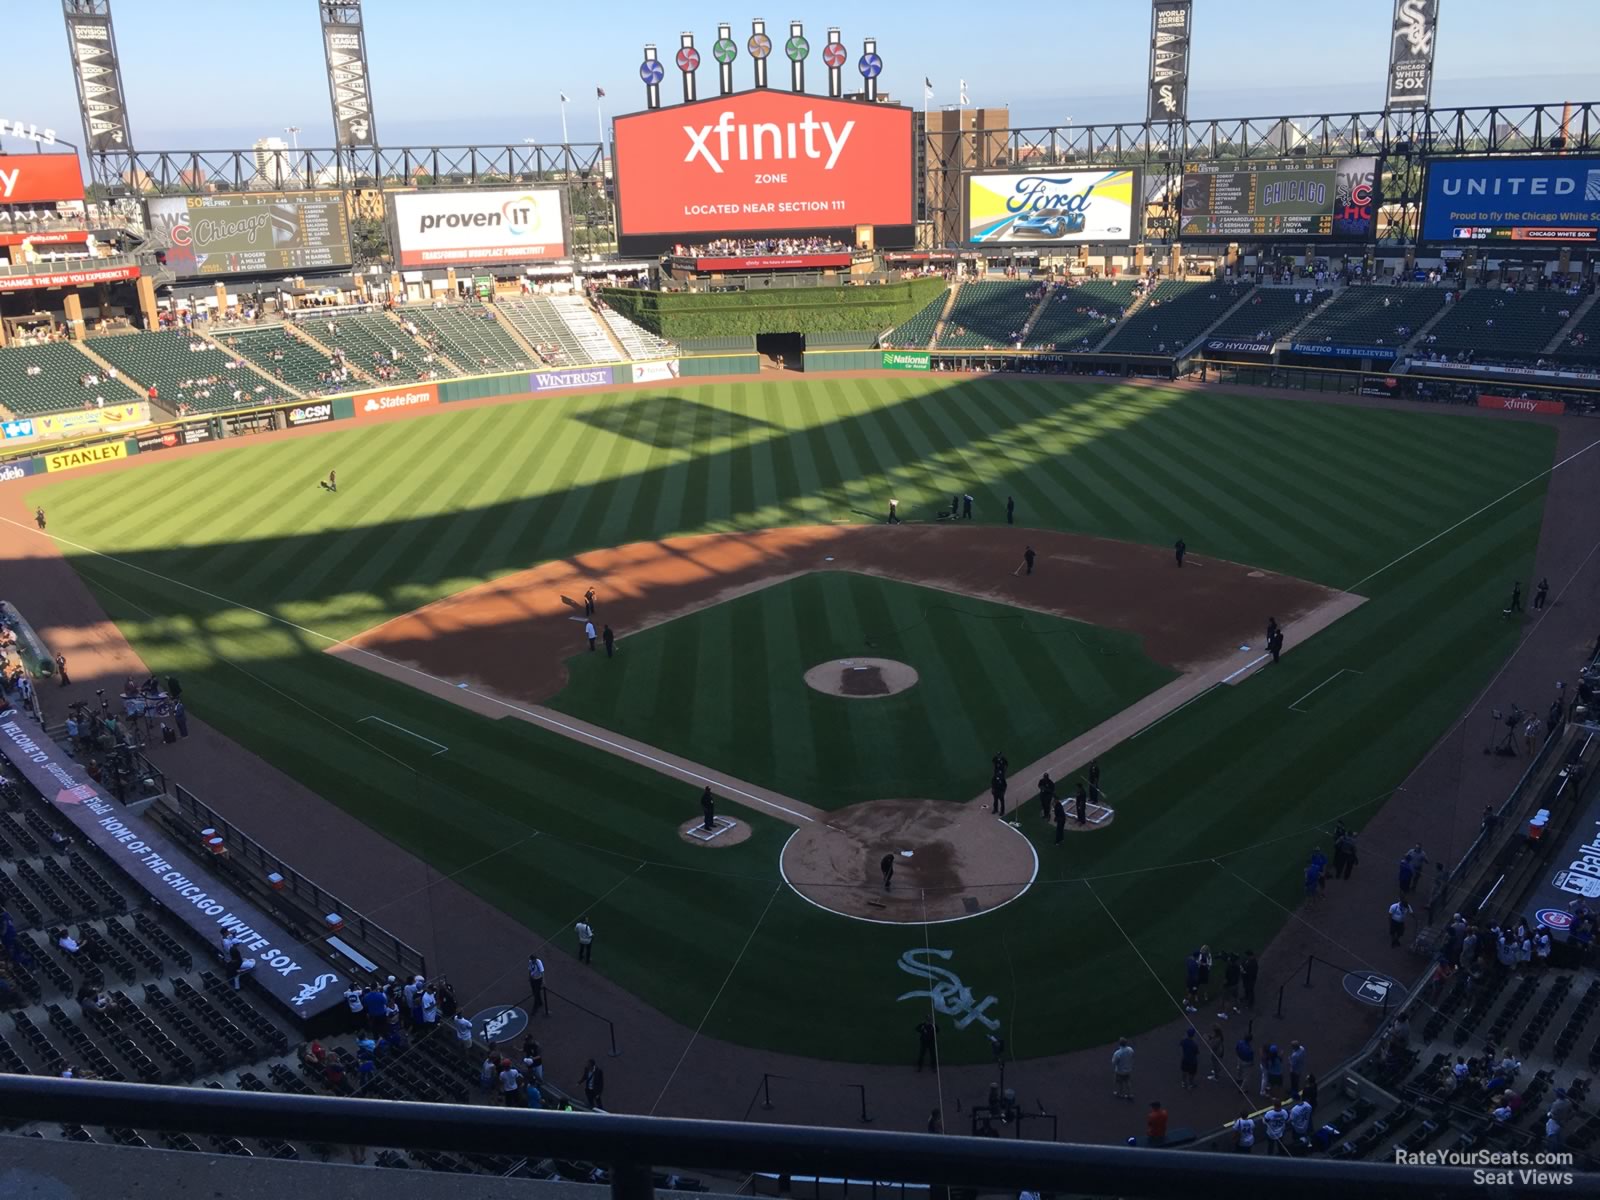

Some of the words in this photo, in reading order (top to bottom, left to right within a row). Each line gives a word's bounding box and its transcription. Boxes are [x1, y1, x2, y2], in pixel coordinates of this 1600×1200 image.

[1158, 16, 1185, 24] SERIES
[1396, 70, 1425, 78] WHITE
[1395, 78, 1424, 89] SOX
[683, 110, 856, 173] xfinity
[1185, 164, 1198, 173] 34
[755, 173, 788, 184] ZONE
[1006, 176, 1094, 213] Ford
[1263, 180, 1325, 206] CHICAGO
[1443, 178, 1576, 196] UNITED
[187, 196, 202, 208] 50
[203, 200, 231, 208] PELFREY
[684, 205, 740, 215] LOCATED
[743, 203, 775, 213] NEAR
[778, 201, 829, 212] SECTION
[832, 200, 845, 210] 111
[420, 212, 502, 233] proven
[512, 208, 530, 225] IT
[1450, 212, 1477, 221] Proud
[1479, 213, 1488, 221] to
[1490, 212, 1501, 222] fly
[1505, 212, 1520, 221] the
[1521, 212, 1558, 223] Chicago
[1560, 212, 1588, 221] White
[194, 212, 270, 247] Chicago
[422, 249, 467, 260] TRANSFORMING
[468, 248, 504, 258] WORKPLACE
[503, 246, 545, 257] PRODUCTIVITY
[0, 278, 33, 288] CHANGE
[36, 277, 51, 285] THE
[51, 276, 69, 284] WAY
[69, 274, 85, 282] YOU
[86, 271, 122, 281] EXPERIENCE
[1225, 343, 1270, 352] HYUNDAI
[1294, 344, 1332, 353] ATHLETICO
[1352, 349, 1394, 357] RELIEVERS
[893, 355, 929, 365] National
[536, 371, 607, 387] WINTRUST
[305, 404, 331, 418] CSN
[1504, 399, 1538, 411] xfinity
[52, 445, 120, 469] STANLEY
[0, 721, 41, 754] WELCOME
[29, 751, 49, 764] TO
[83, 797, 114, 816] Field
[98, 816, 137, 843] HOME
[127, 838, 152, 855] OF
[140, 853, 173, 875] THE
[162, 871, 225, 916] CHICAGO
[216, 913, 271, 952] WHITE
[260, 948, 302, 977] SOX
